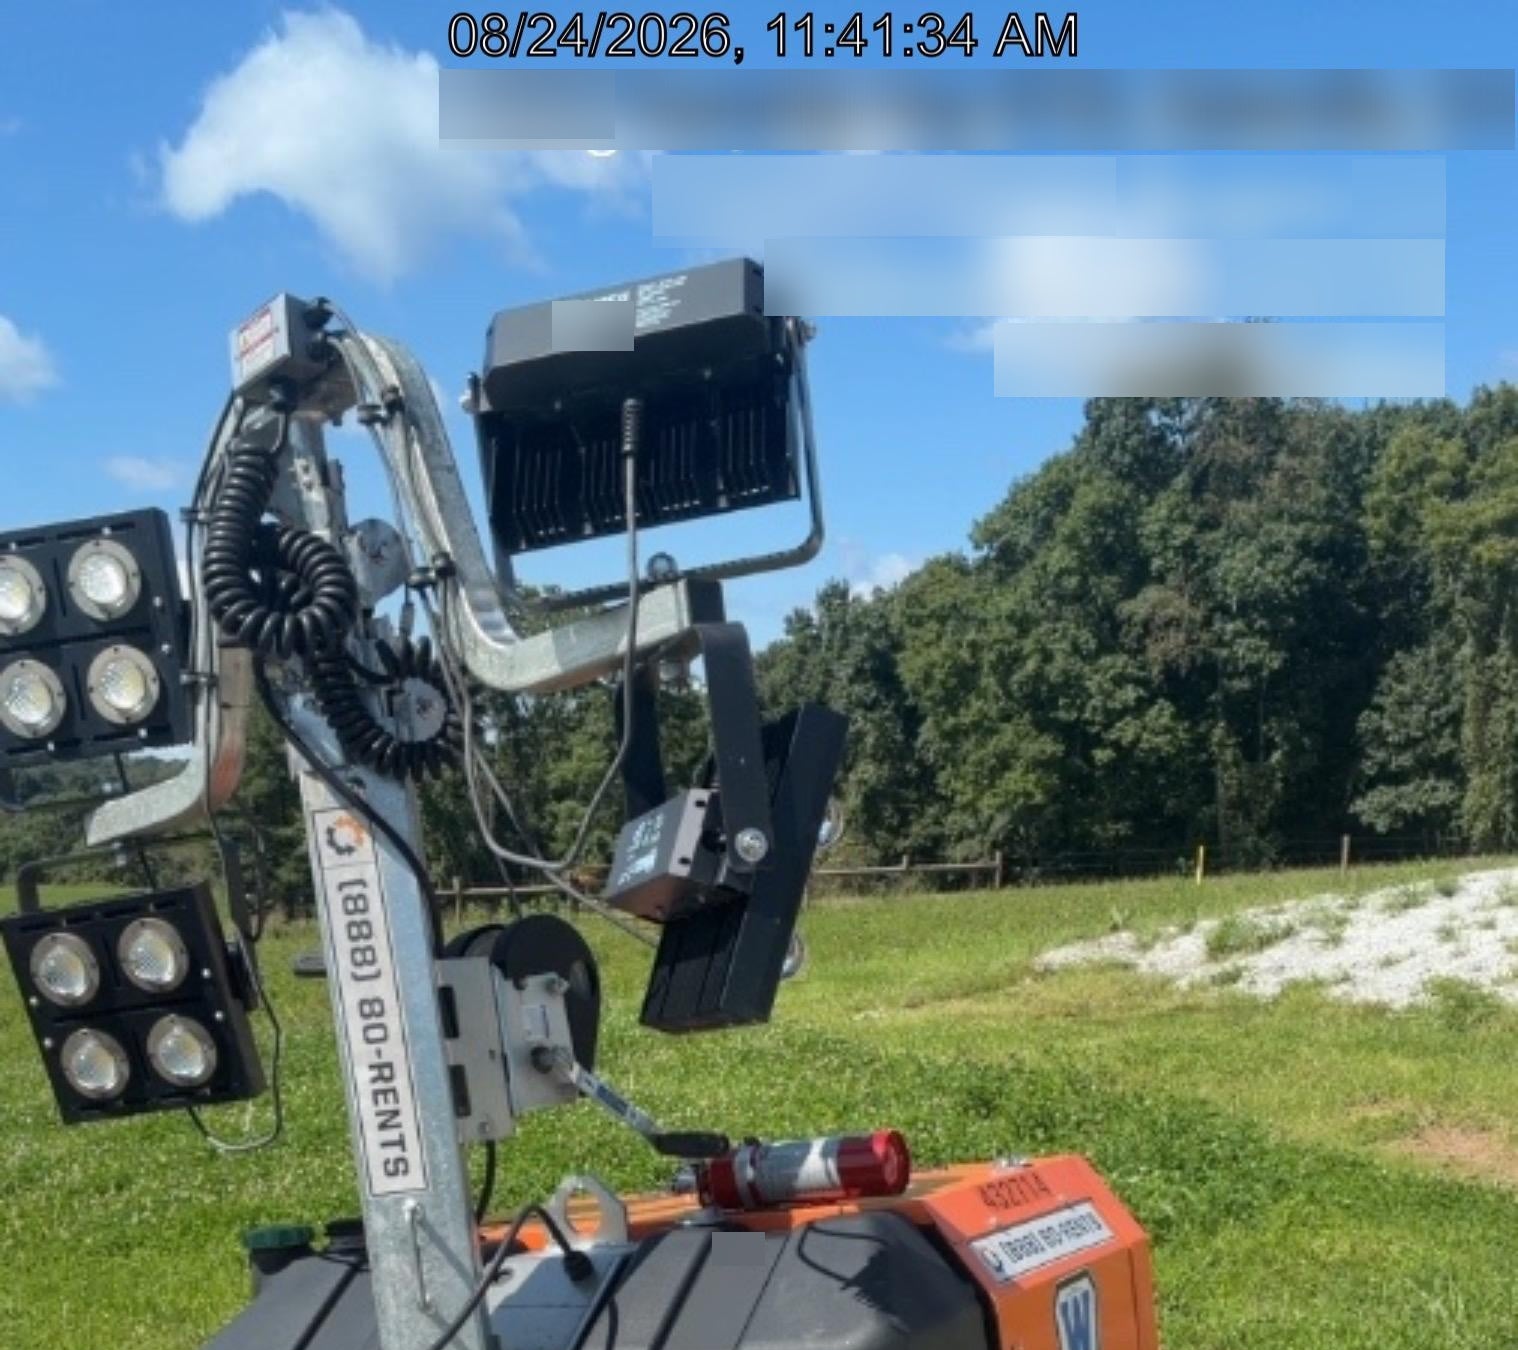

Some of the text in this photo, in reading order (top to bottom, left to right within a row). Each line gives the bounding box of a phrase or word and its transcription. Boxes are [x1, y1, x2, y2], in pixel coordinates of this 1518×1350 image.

[337, 878, 410, 1178] (888) 80-RENTS
[1000, 1211, 1102, 1264] (888) 80-RENTS
